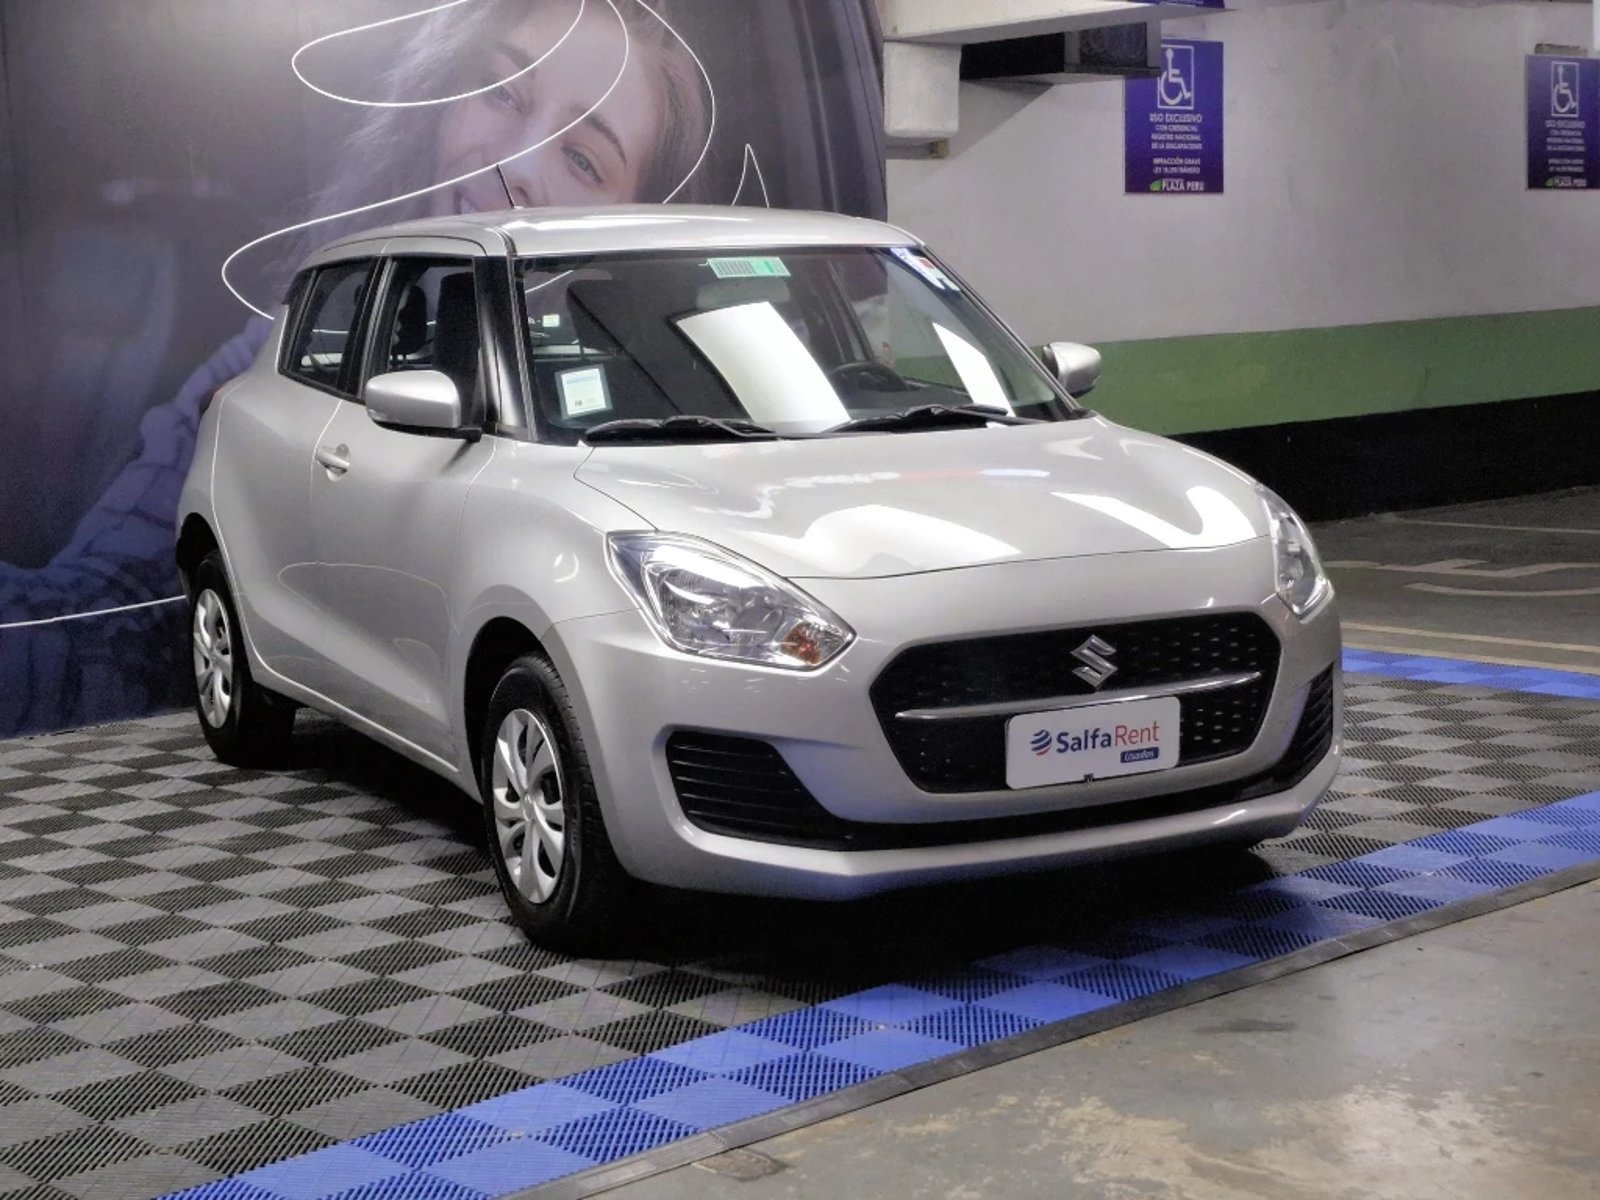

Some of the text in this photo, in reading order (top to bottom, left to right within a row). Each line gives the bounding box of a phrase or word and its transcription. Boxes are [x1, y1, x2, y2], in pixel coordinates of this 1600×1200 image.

[1165, 113, 1202, 123] EXCLUSIVO
[1162, 180, 1185, 191] PLAZA
[1124, 750, 1154, 761] Usados
